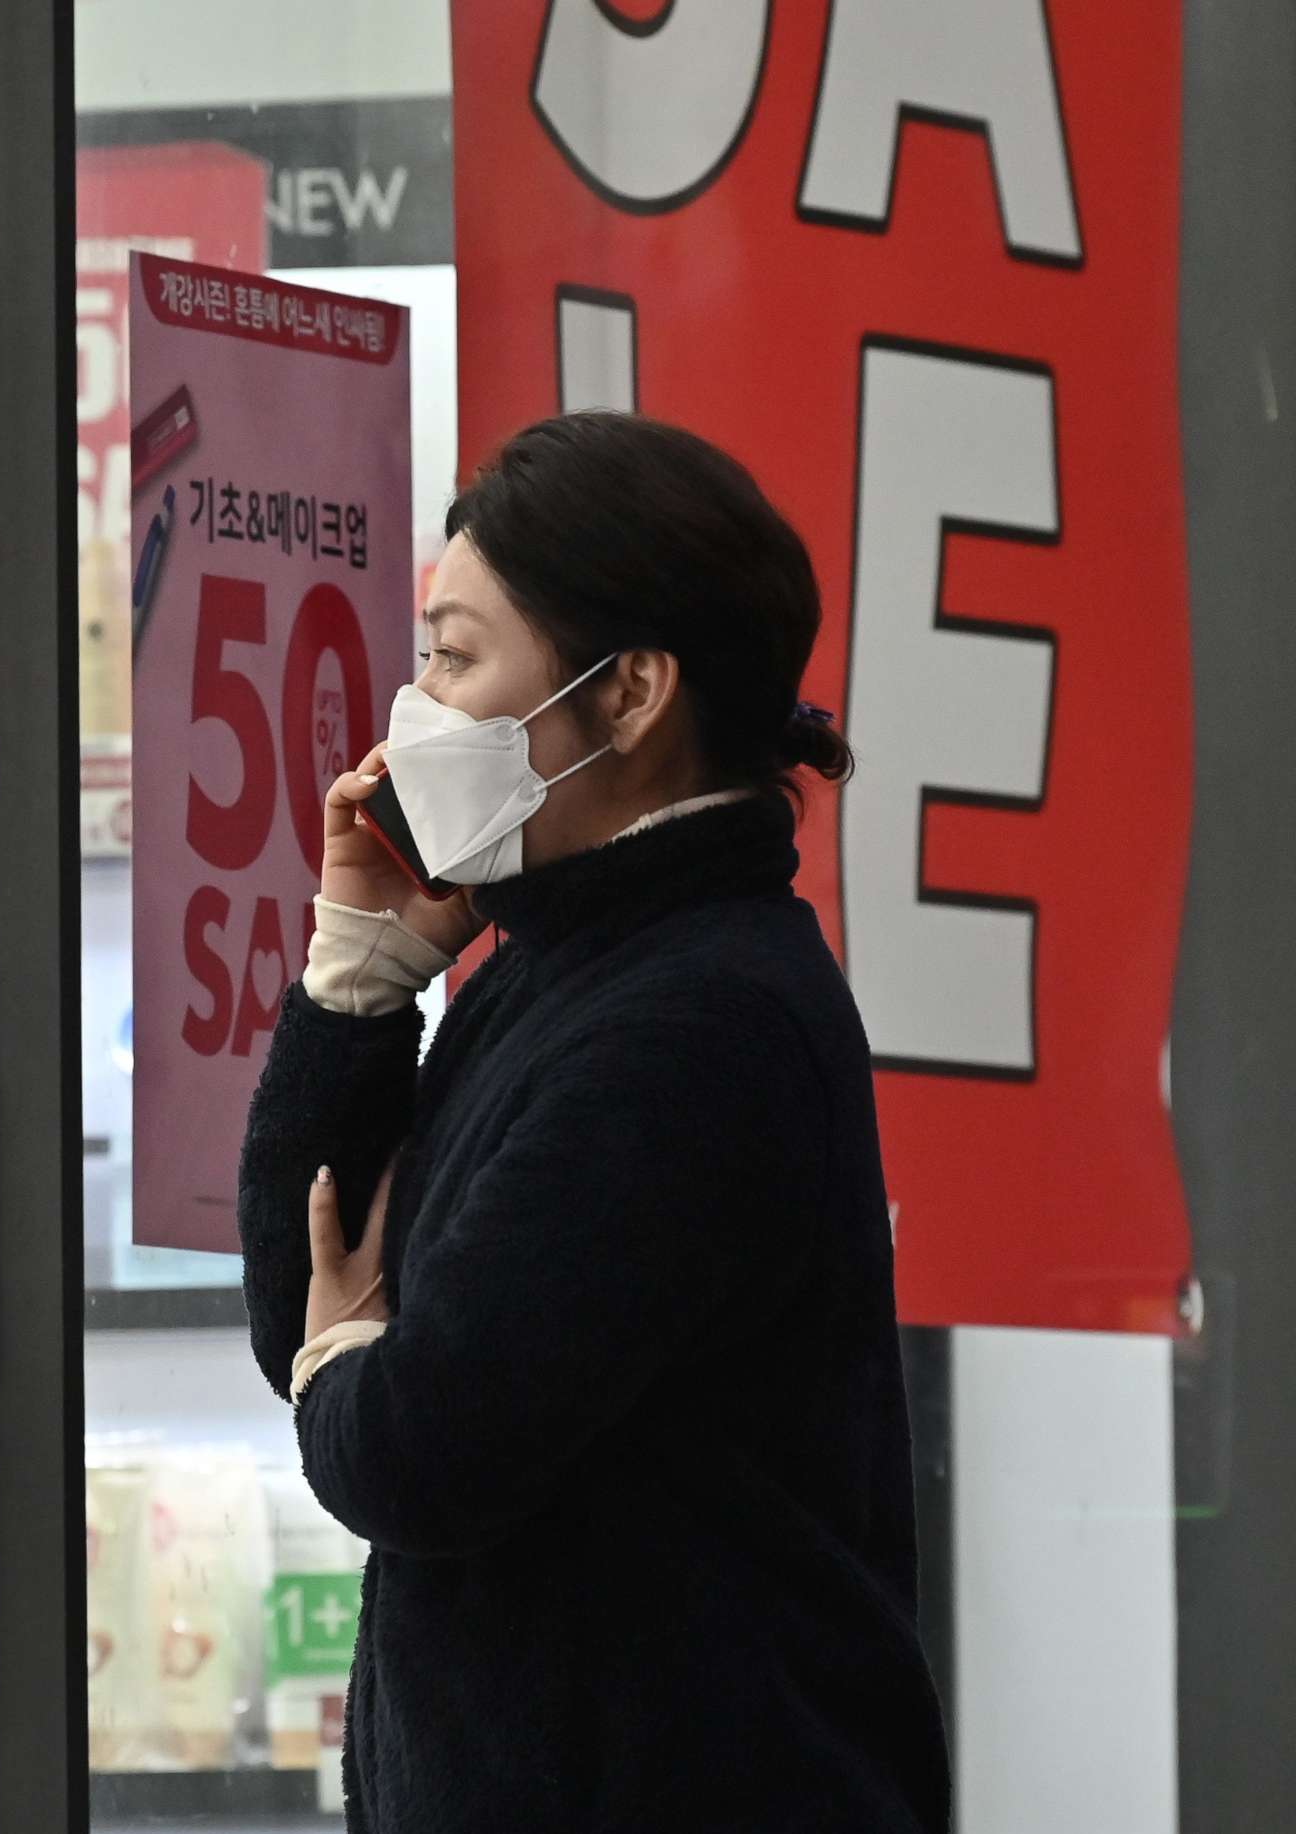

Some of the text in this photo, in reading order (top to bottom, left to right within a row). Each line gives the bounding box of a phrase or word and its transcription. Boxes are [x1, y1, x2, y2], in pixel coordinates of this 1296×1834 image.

[265, 167, 408, 236] NEW
[189, 476, 367, 570] 기초&메이크업
[186, 574, 374, 880] 50
